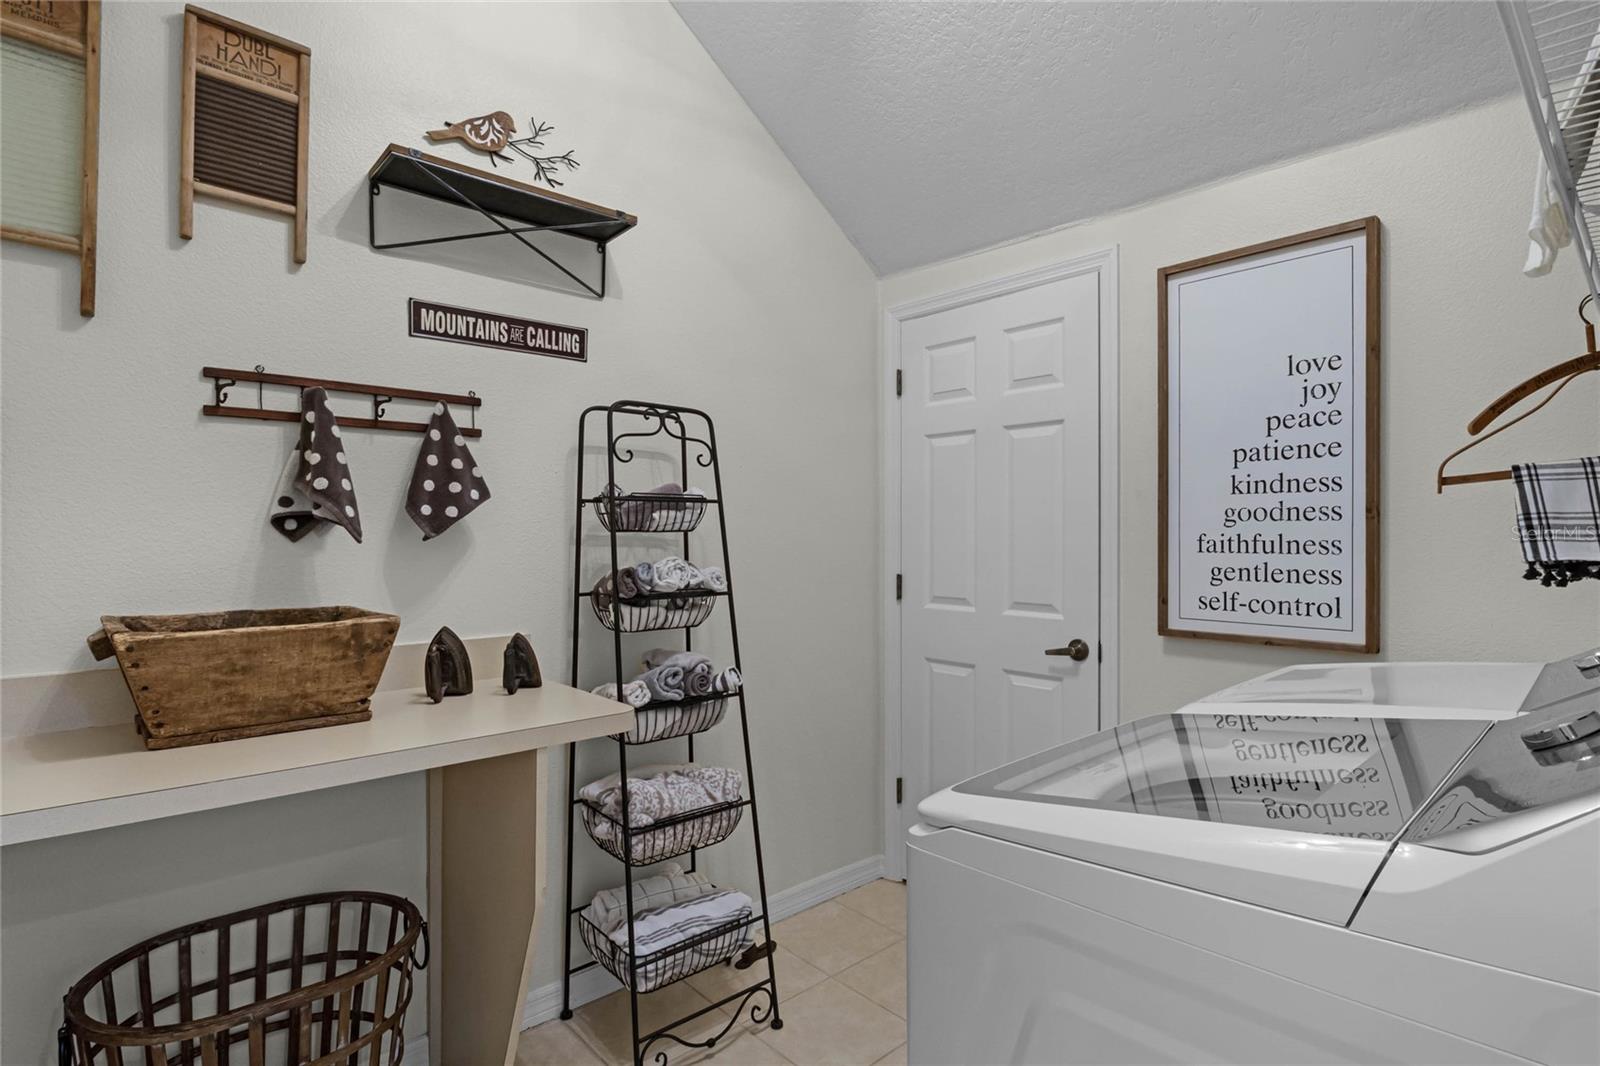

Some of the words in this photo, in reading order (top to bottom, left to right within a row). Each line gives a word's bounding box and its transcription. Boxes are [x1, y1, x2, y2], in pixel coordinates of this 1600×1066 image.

[224, 29, 275, 61] DUBL
[216, 43, 282, 81] HANDI
[420, 308, 508, 343] MOUNTAINS
[510, 328, 524, 343] ARE
[526, 326, 580, 354] CALLING
[1287, 353, 1343, 377] love
[1299, 378, 1343, 408] joy
[1265, 408, 1343, 438] peace
[1232, 439, 1343, 469] patience
[1230, 472, 1343, 495] kindness
[1223, 500, 1343, 528] goodness
[1196, 533, 1343, 556] faithfulness
[1209, 562, 1343, 587] gentleness
[1198, 591, 1343, 619] self-control
